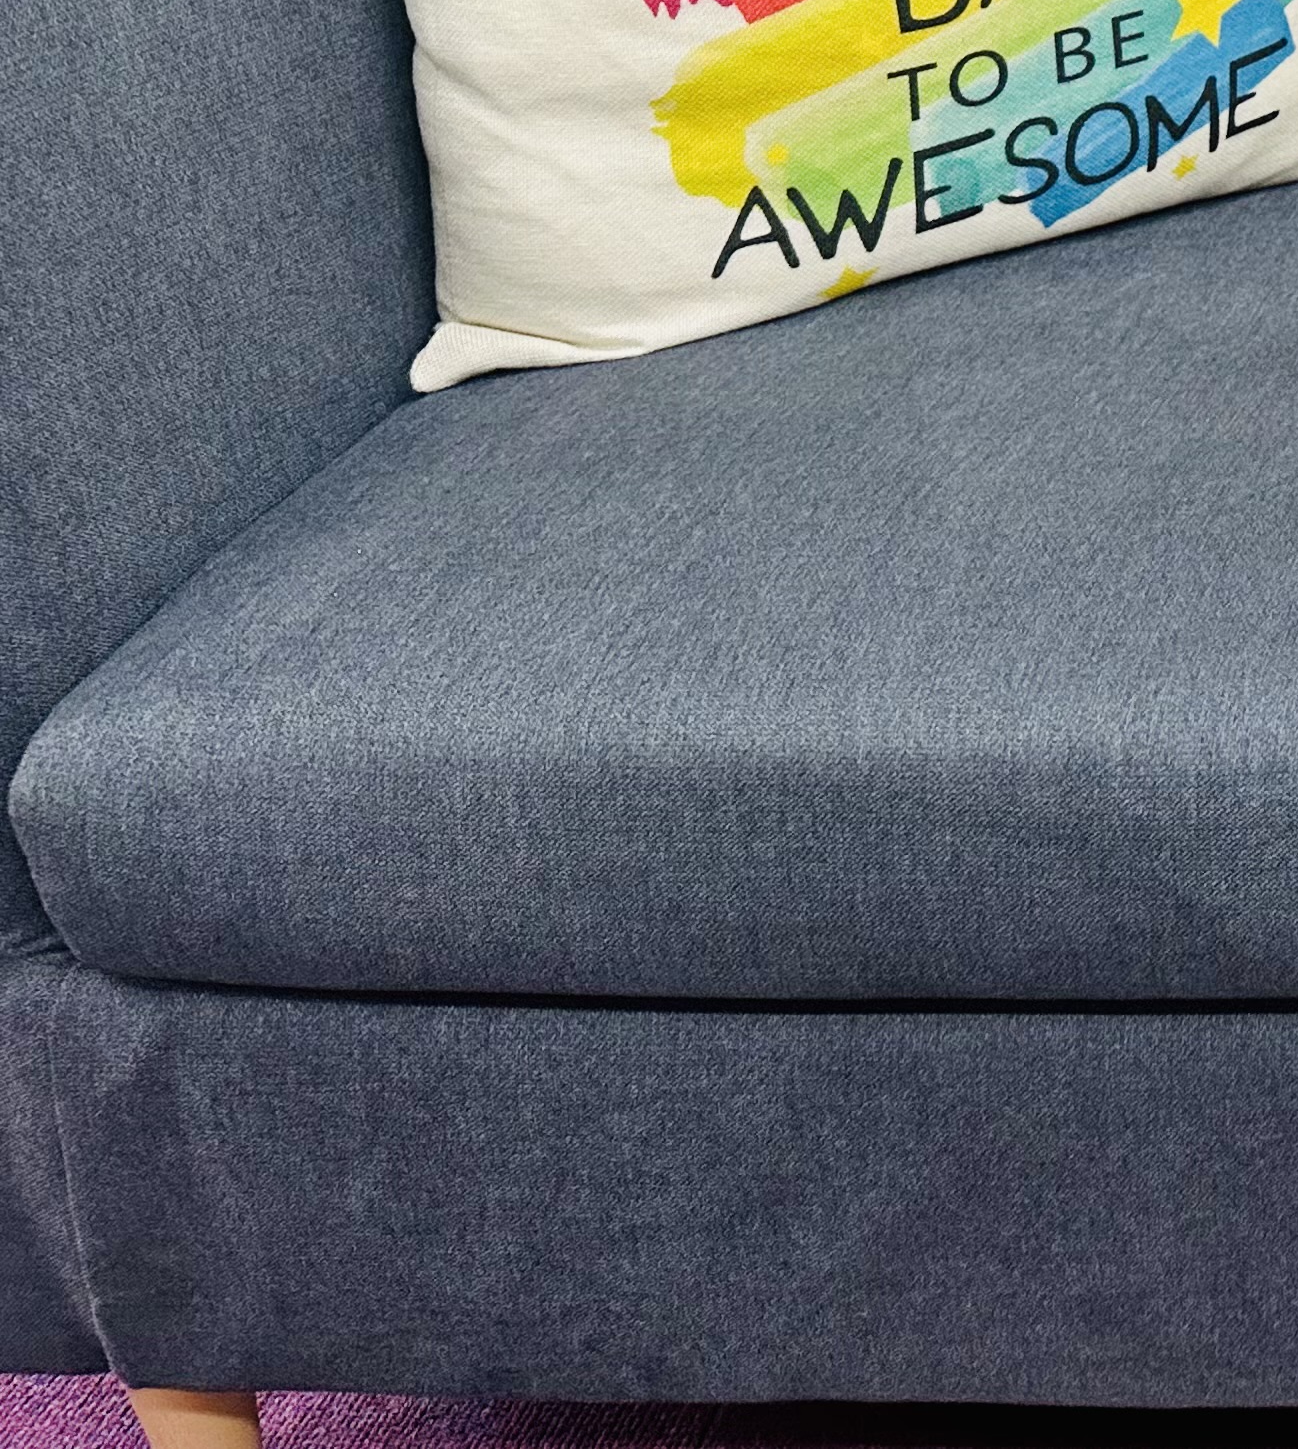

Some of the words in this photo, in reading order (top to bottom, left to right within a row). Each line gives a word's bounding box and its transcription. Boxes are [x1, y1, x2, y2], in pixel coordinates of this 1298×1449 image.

[887, 49, 1010, 122] TO
[1055, 9, 1150, 85] BE
[710, 37, 1290, 279] AWESOME
